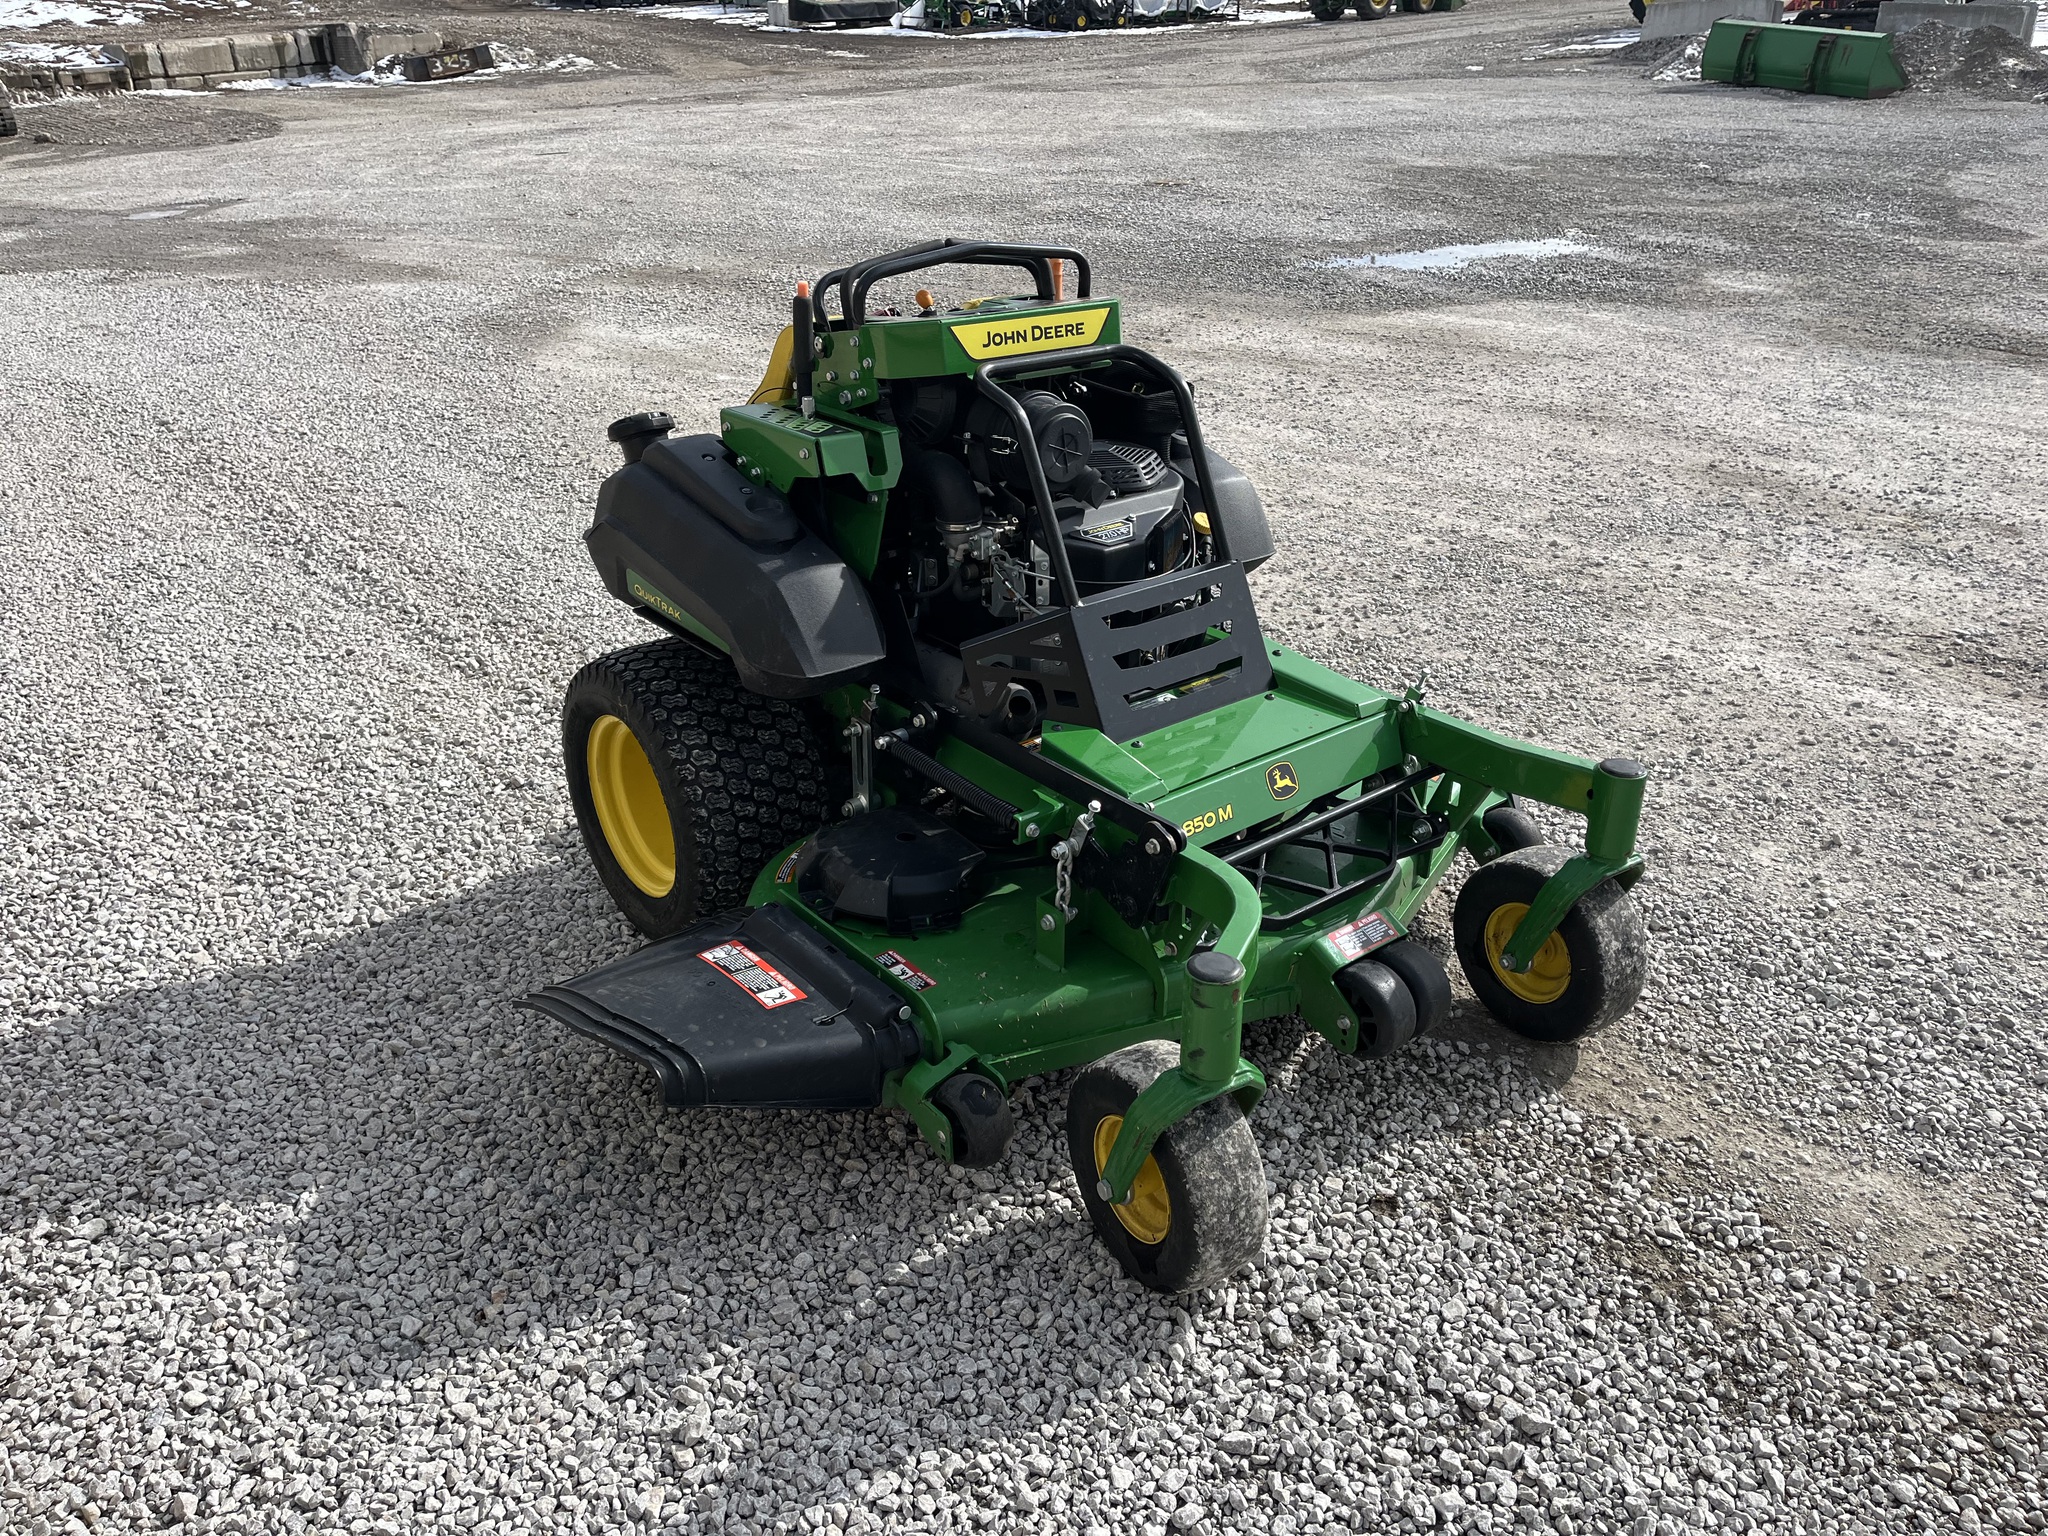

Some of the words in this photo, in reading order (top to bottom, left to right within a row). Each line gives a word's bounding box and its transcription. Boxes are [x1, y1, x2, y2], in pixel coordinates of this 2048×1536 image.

[982, 329, 1028, 349] JOHN
[1031, 322, 1085, 342] DEERE
[1182, 811, 1217, 837] 850
[1217, 803, 1234, 823] M
